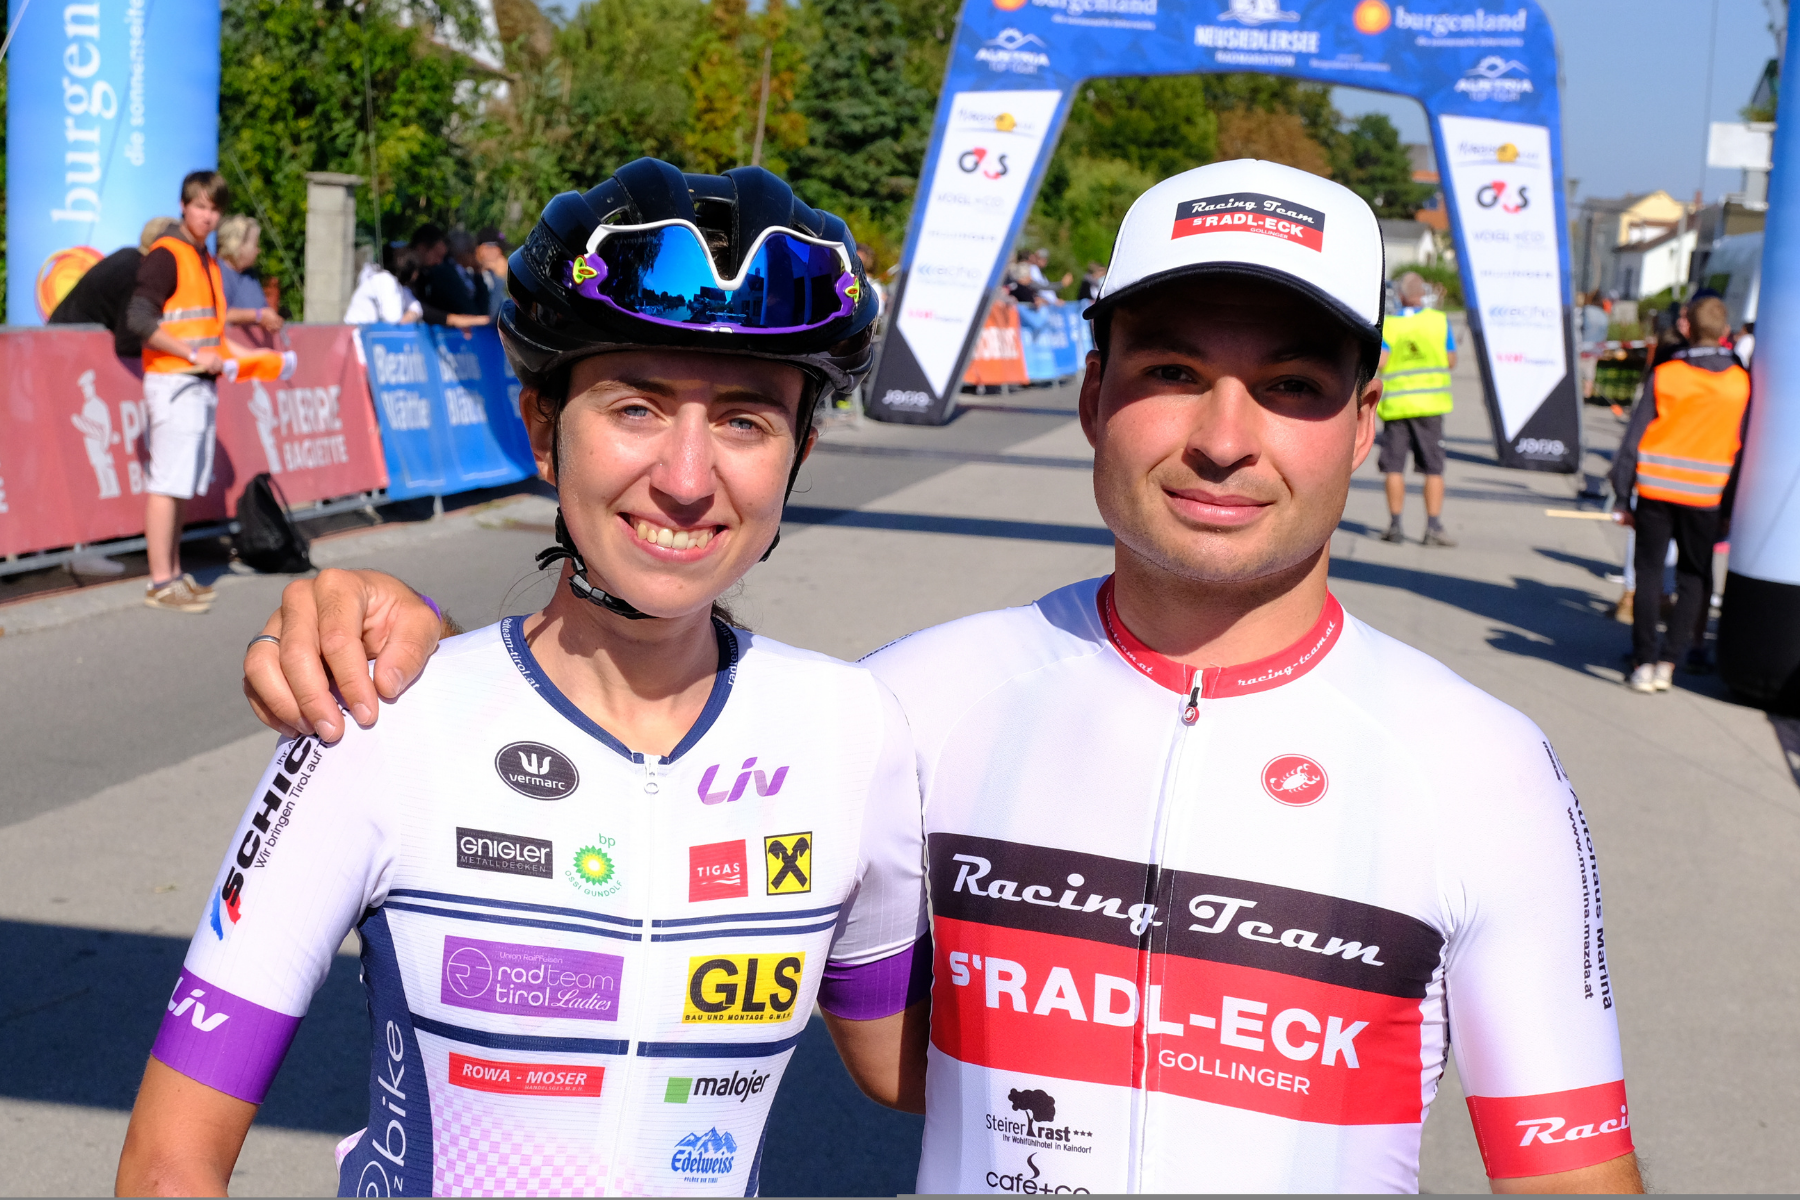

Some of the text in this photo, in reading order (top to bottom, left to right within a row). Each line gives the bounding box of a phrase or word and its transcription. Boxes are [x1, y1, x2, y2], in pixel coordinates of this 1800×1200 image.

[1192, 198, 1315, 224] Racing Team
[1250, 227, 1289, 240] GOLLINGER
[1237, 620, 1337, 687] racing-team.at
[508, 773, 566, 791] vermarc
[697, 757, 790, 806] Liv
[221, 733, 320, 908] SCHIC
[254, 847, 271, 869] Wir
[265, 801, 296, 847] bringen
[289, 772, 311, 799] Tirol
[307, 749, 323, 773] auf
[598, 833, 616, 848] bp
[460, 855, 547, 873] METALLDECKEN
[697, 862, 740, 877] TIGAS
[565, 869, 623, 897] OSSI GUNDOLF
[951, 853, 1385, 967] Racing Team
[496, 984, 612, 1011] tirol Ladies
[690, 957, 801, 1013] GLS
[462, 1063, 511, 1083] ROWA
[526, 1071, 588, 1086] MOSER
[694, 1069, 771, 1103] malojer
[1159, 1049, 1311, 1095] GOLLINGER
[372, 1020, 406, 1166] bike
[1515, 1105, 1631, 1147] Raci
[1002, 1134, 1010, 1142] Ihr
[1063, 1144, 1092, 1154] Kaindorf
[671, 1149, 735, 1174] Edelweiss
